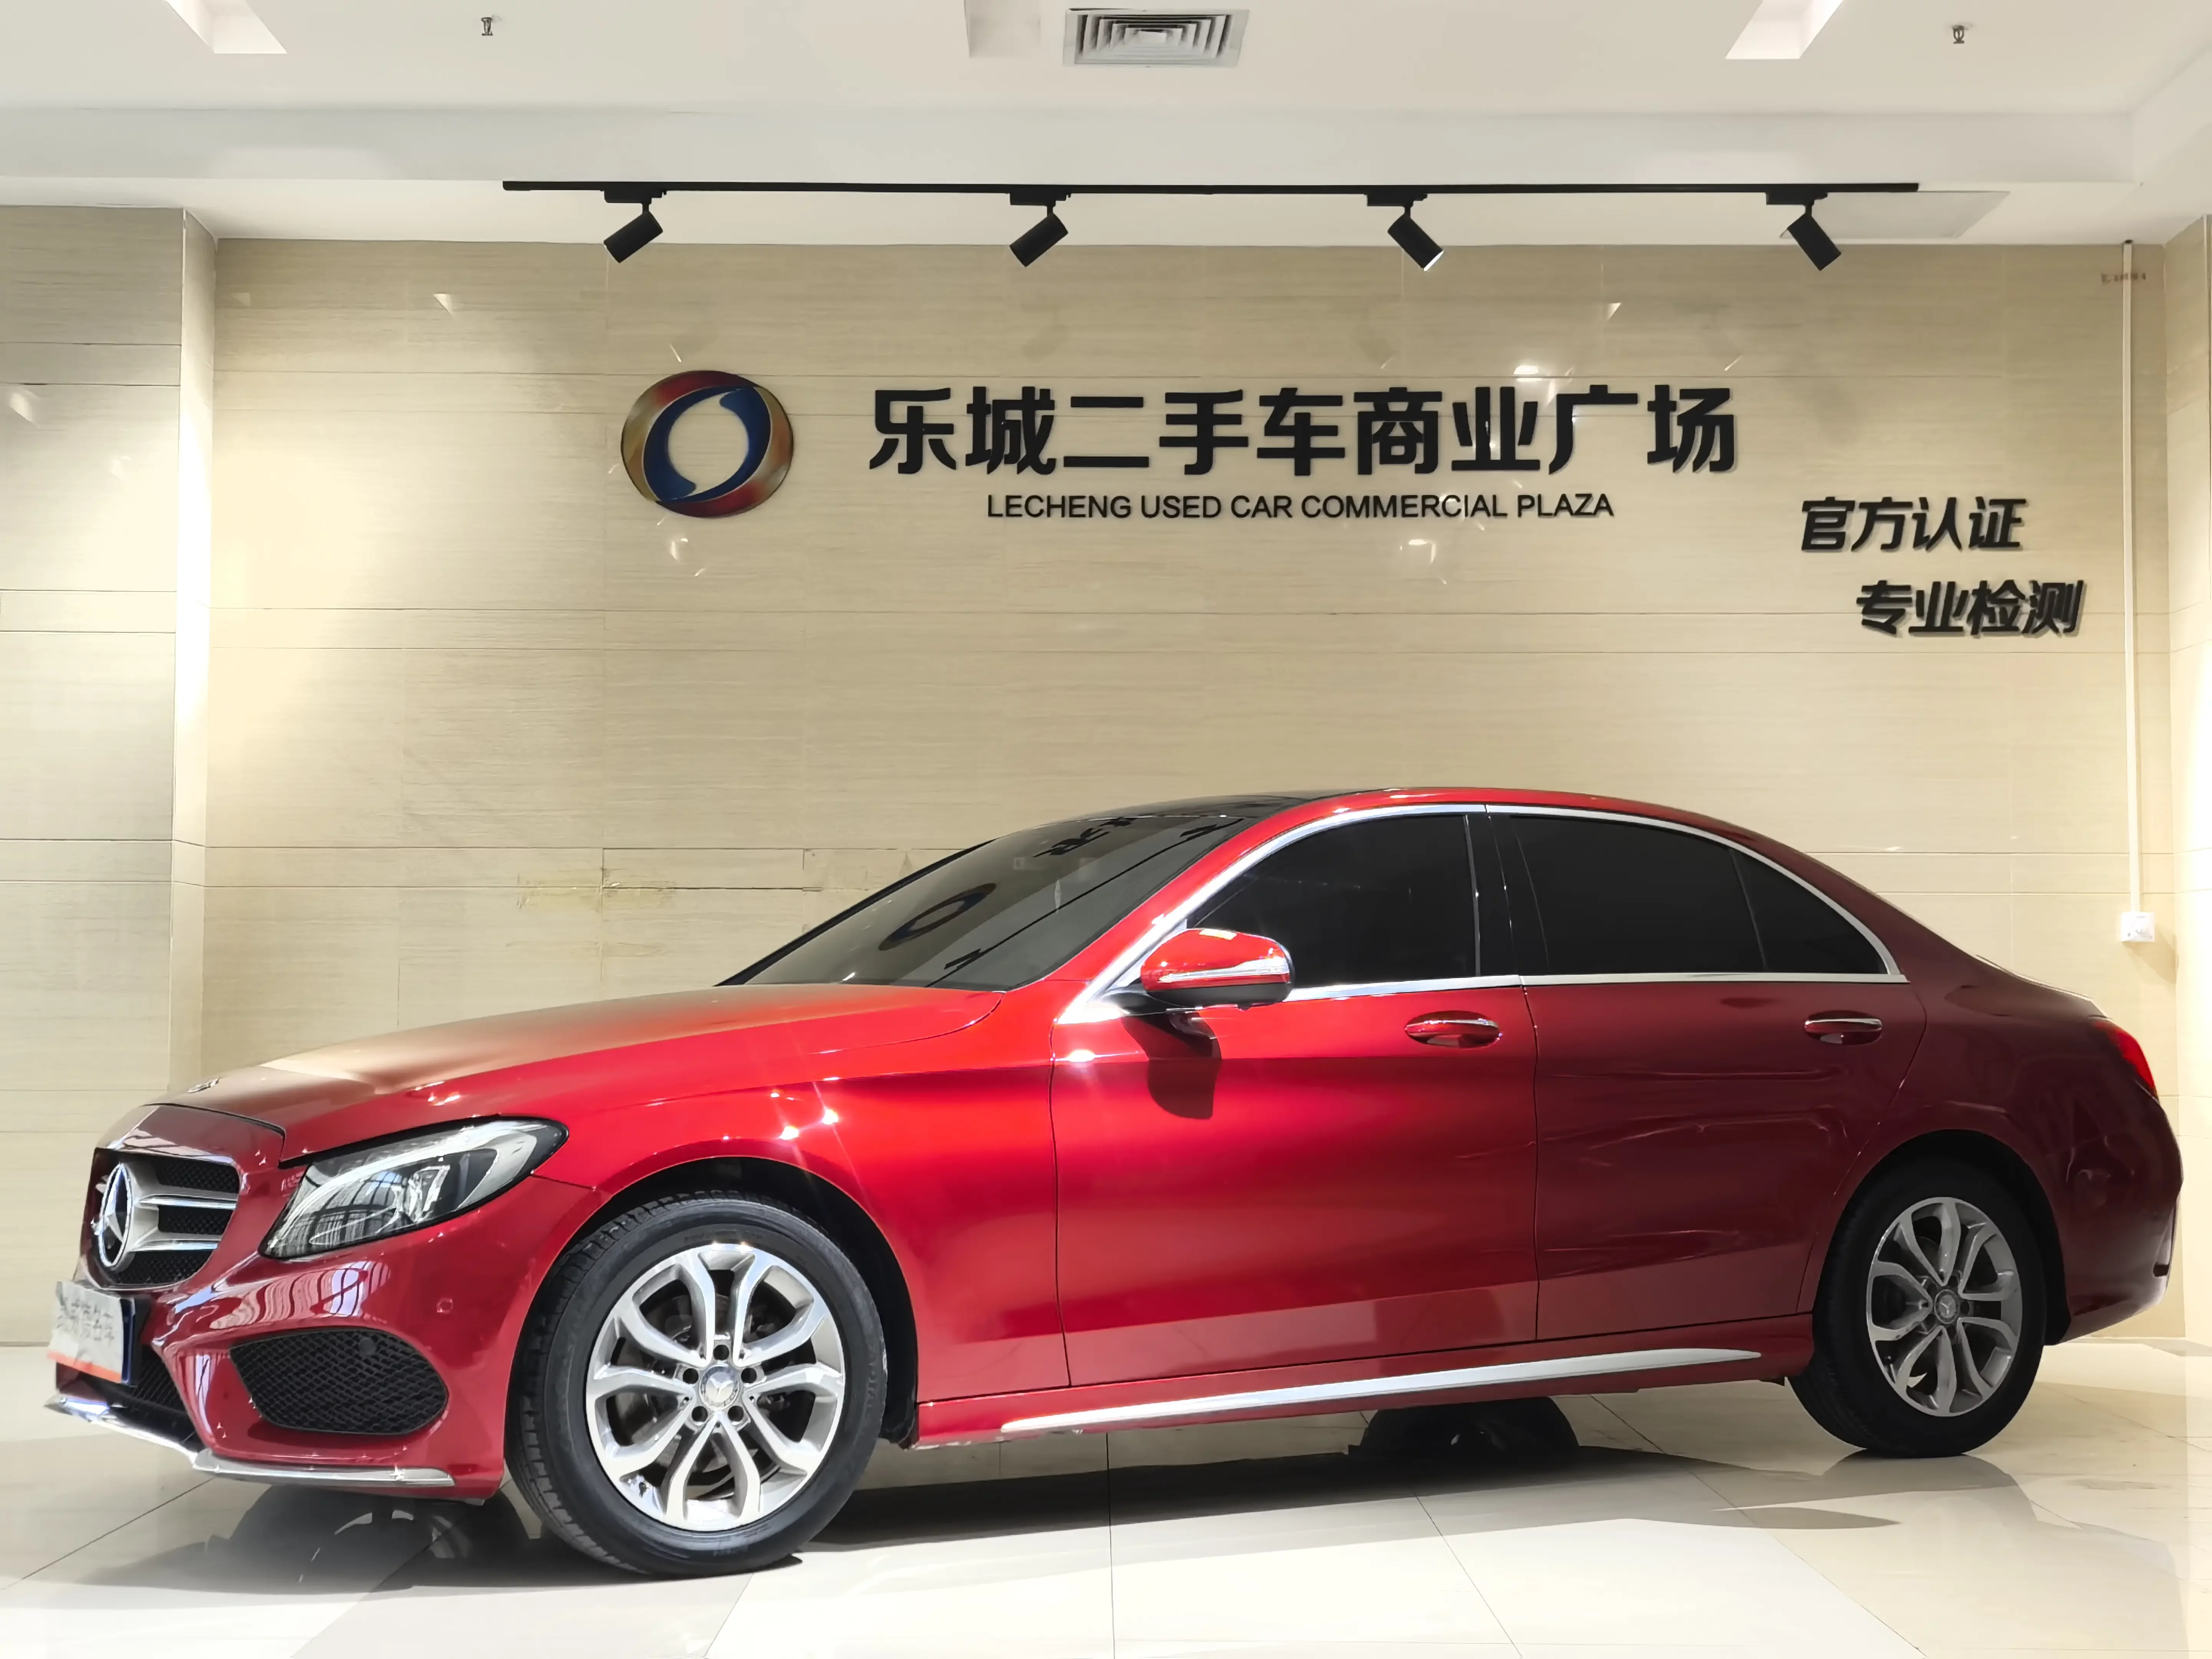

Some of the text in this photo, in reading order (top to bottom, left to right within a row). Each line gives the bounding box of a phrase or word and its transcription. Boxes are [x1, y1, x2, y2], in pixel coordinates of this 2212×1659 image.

[869, 384, 1735, 477] 乐城二手车商业广场
[987, 493, 1614, 519] LECHENG USED CAR COMMERCIAL PLAZA
[1801, 496, 2027, 552] 官方认证
[1856, 579, 2085, 636] 专业检测
